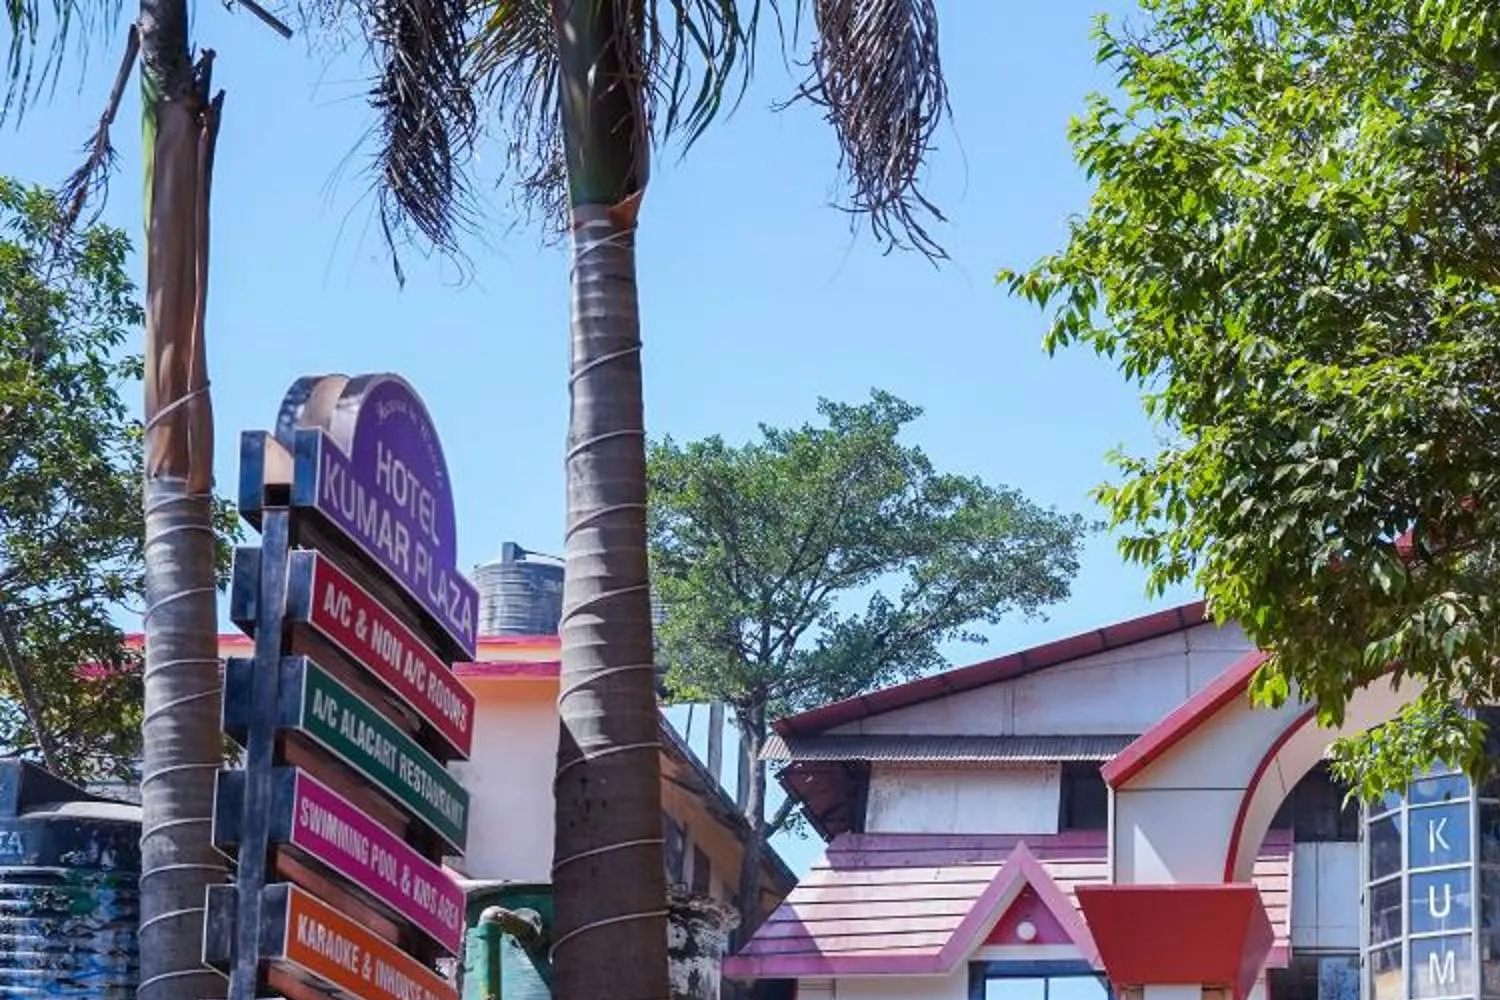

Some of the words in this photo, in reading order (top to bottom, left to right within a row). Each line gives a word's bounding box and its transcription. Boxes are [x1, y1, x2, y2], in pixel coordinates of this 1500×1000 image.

[324, 453, 410, 573] KUMAR
[414, 541, 473, 643] PLAZA
[376, 440, 440, 546] HOTEL
[323, 582, 352, 628] A/C
[355, 608, 368, 641] &
[371, 619, 403, 671] NON
[403, 650, 427, 692] A/C
[427, 671, 468, 733] ROOMS
[313, 688, 338, 728] A/C
[340, 708, 398, 773] ALACART
[399, 753, 465, 830] RESTAURANT
[300, 797, 369, 866] SWIMMING
[371, 844, 398, 887] POOL
[401, 864, 411, 897] &
[297, 912, 360, 974] KARAOKE
[362, 952, 372, 981] &
